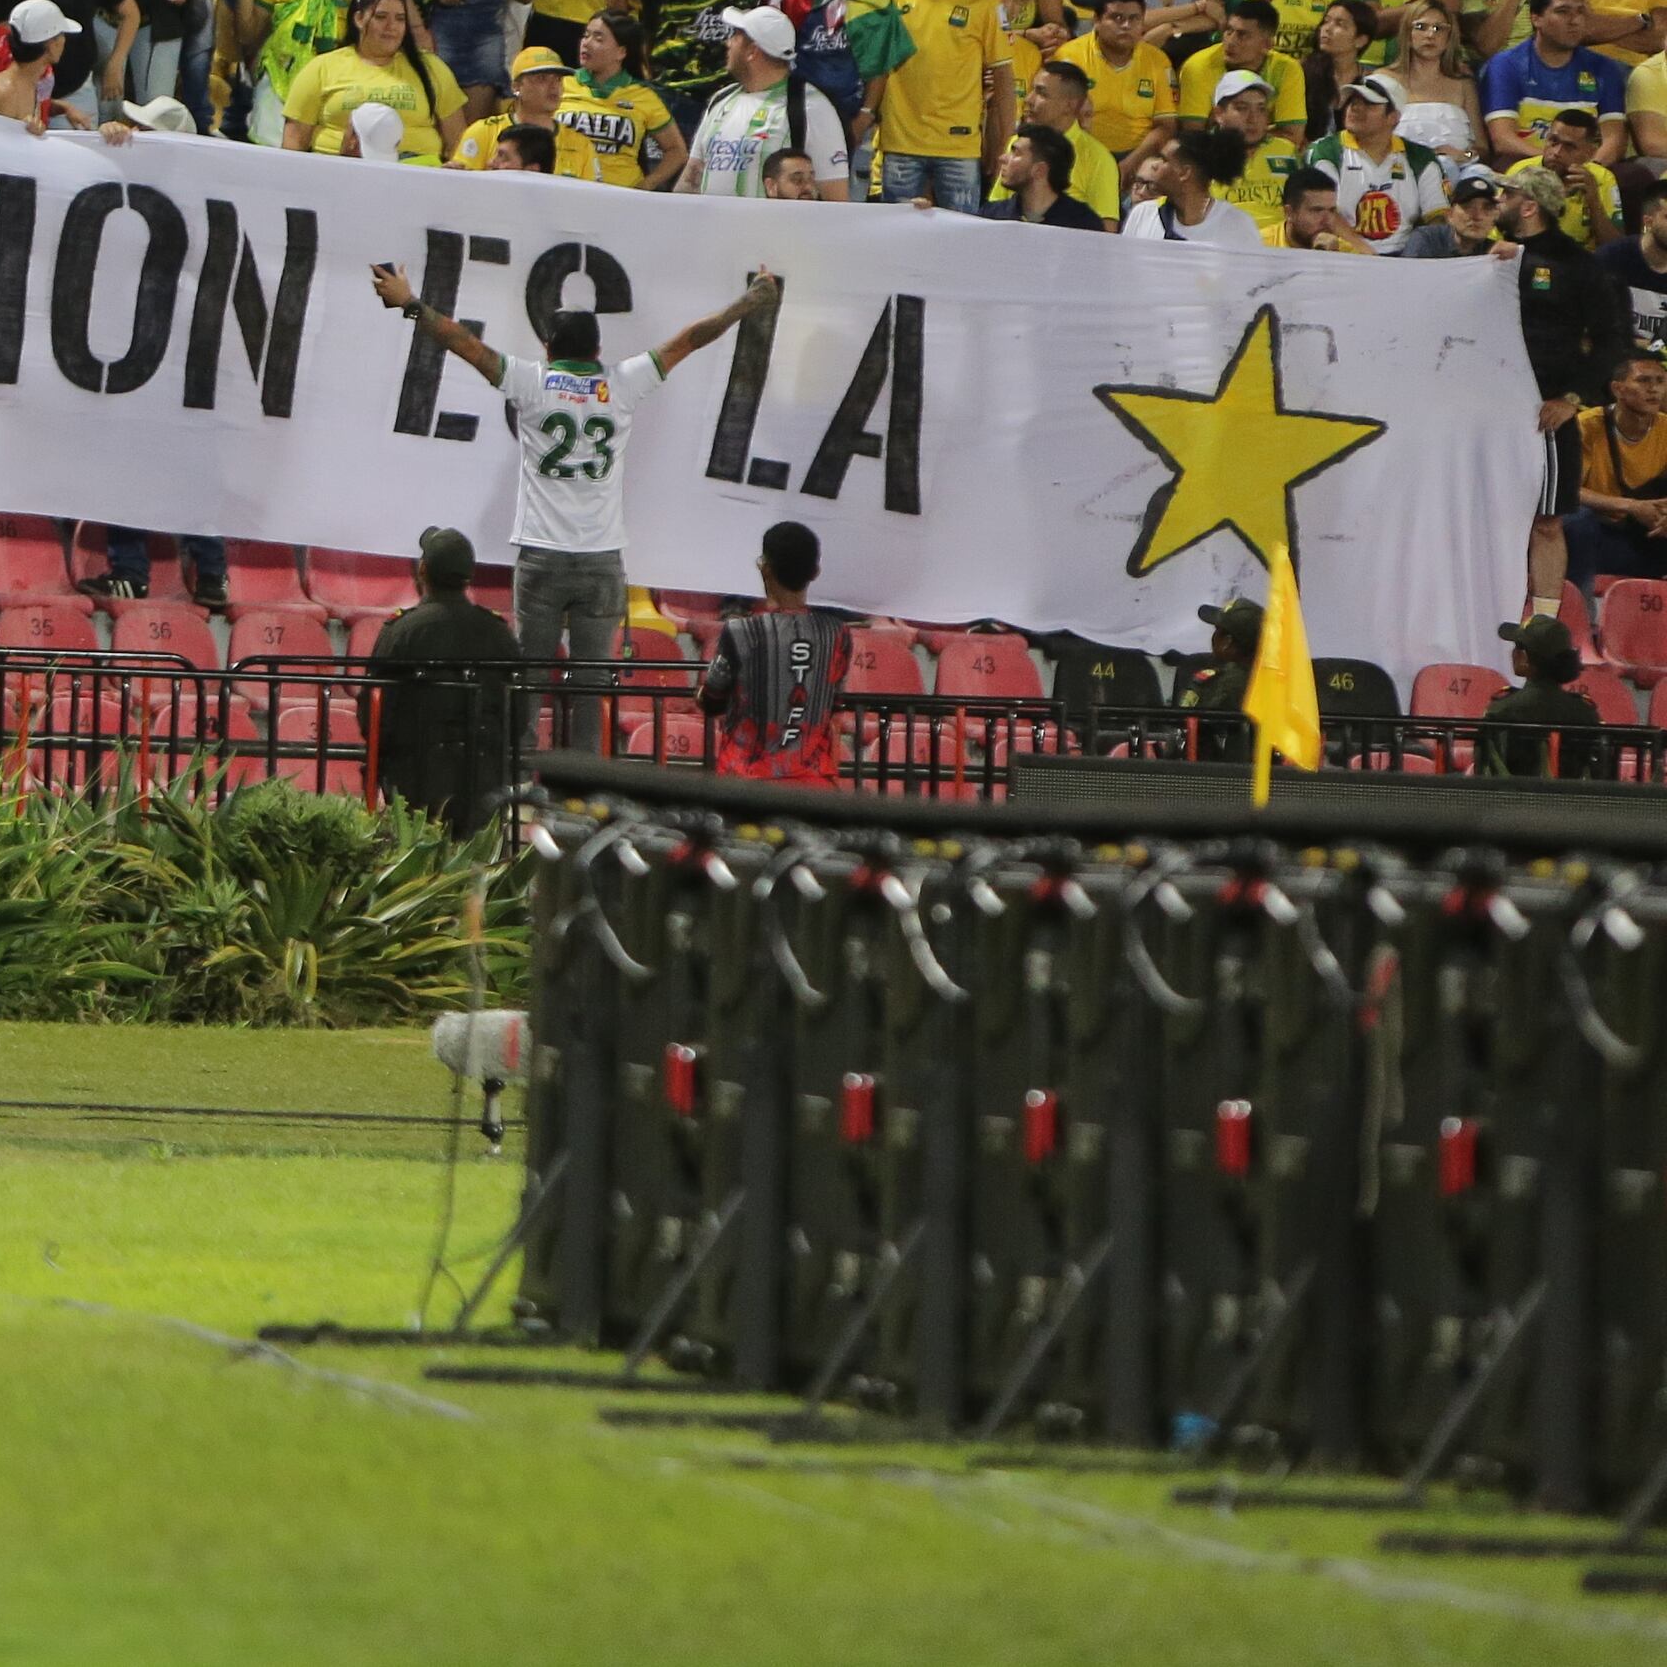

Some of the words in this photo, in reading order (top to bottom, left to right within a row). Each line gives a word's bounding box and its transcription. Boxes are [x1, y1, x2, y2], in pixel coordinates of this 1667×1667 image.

[555, 111, 635, 147] MALTA
[704, 266, 928, 516] LA
[537, 409, 615, 483] 23
[1639, 593, 1663, 612] 50
[30, 618, 53, 637] 35
[149, 622, 172, 639] 36
[264, 626, 286, 644] 37
[853, 651, 876, 670] 42
[971, 657, 995, 675] 43
[1091, 661, 1115, 679] 44
[1329, 672, 1355, 691] 46
[1447, 678, 1471, 696] 47
[782, 641, 809, 747] STAFF
